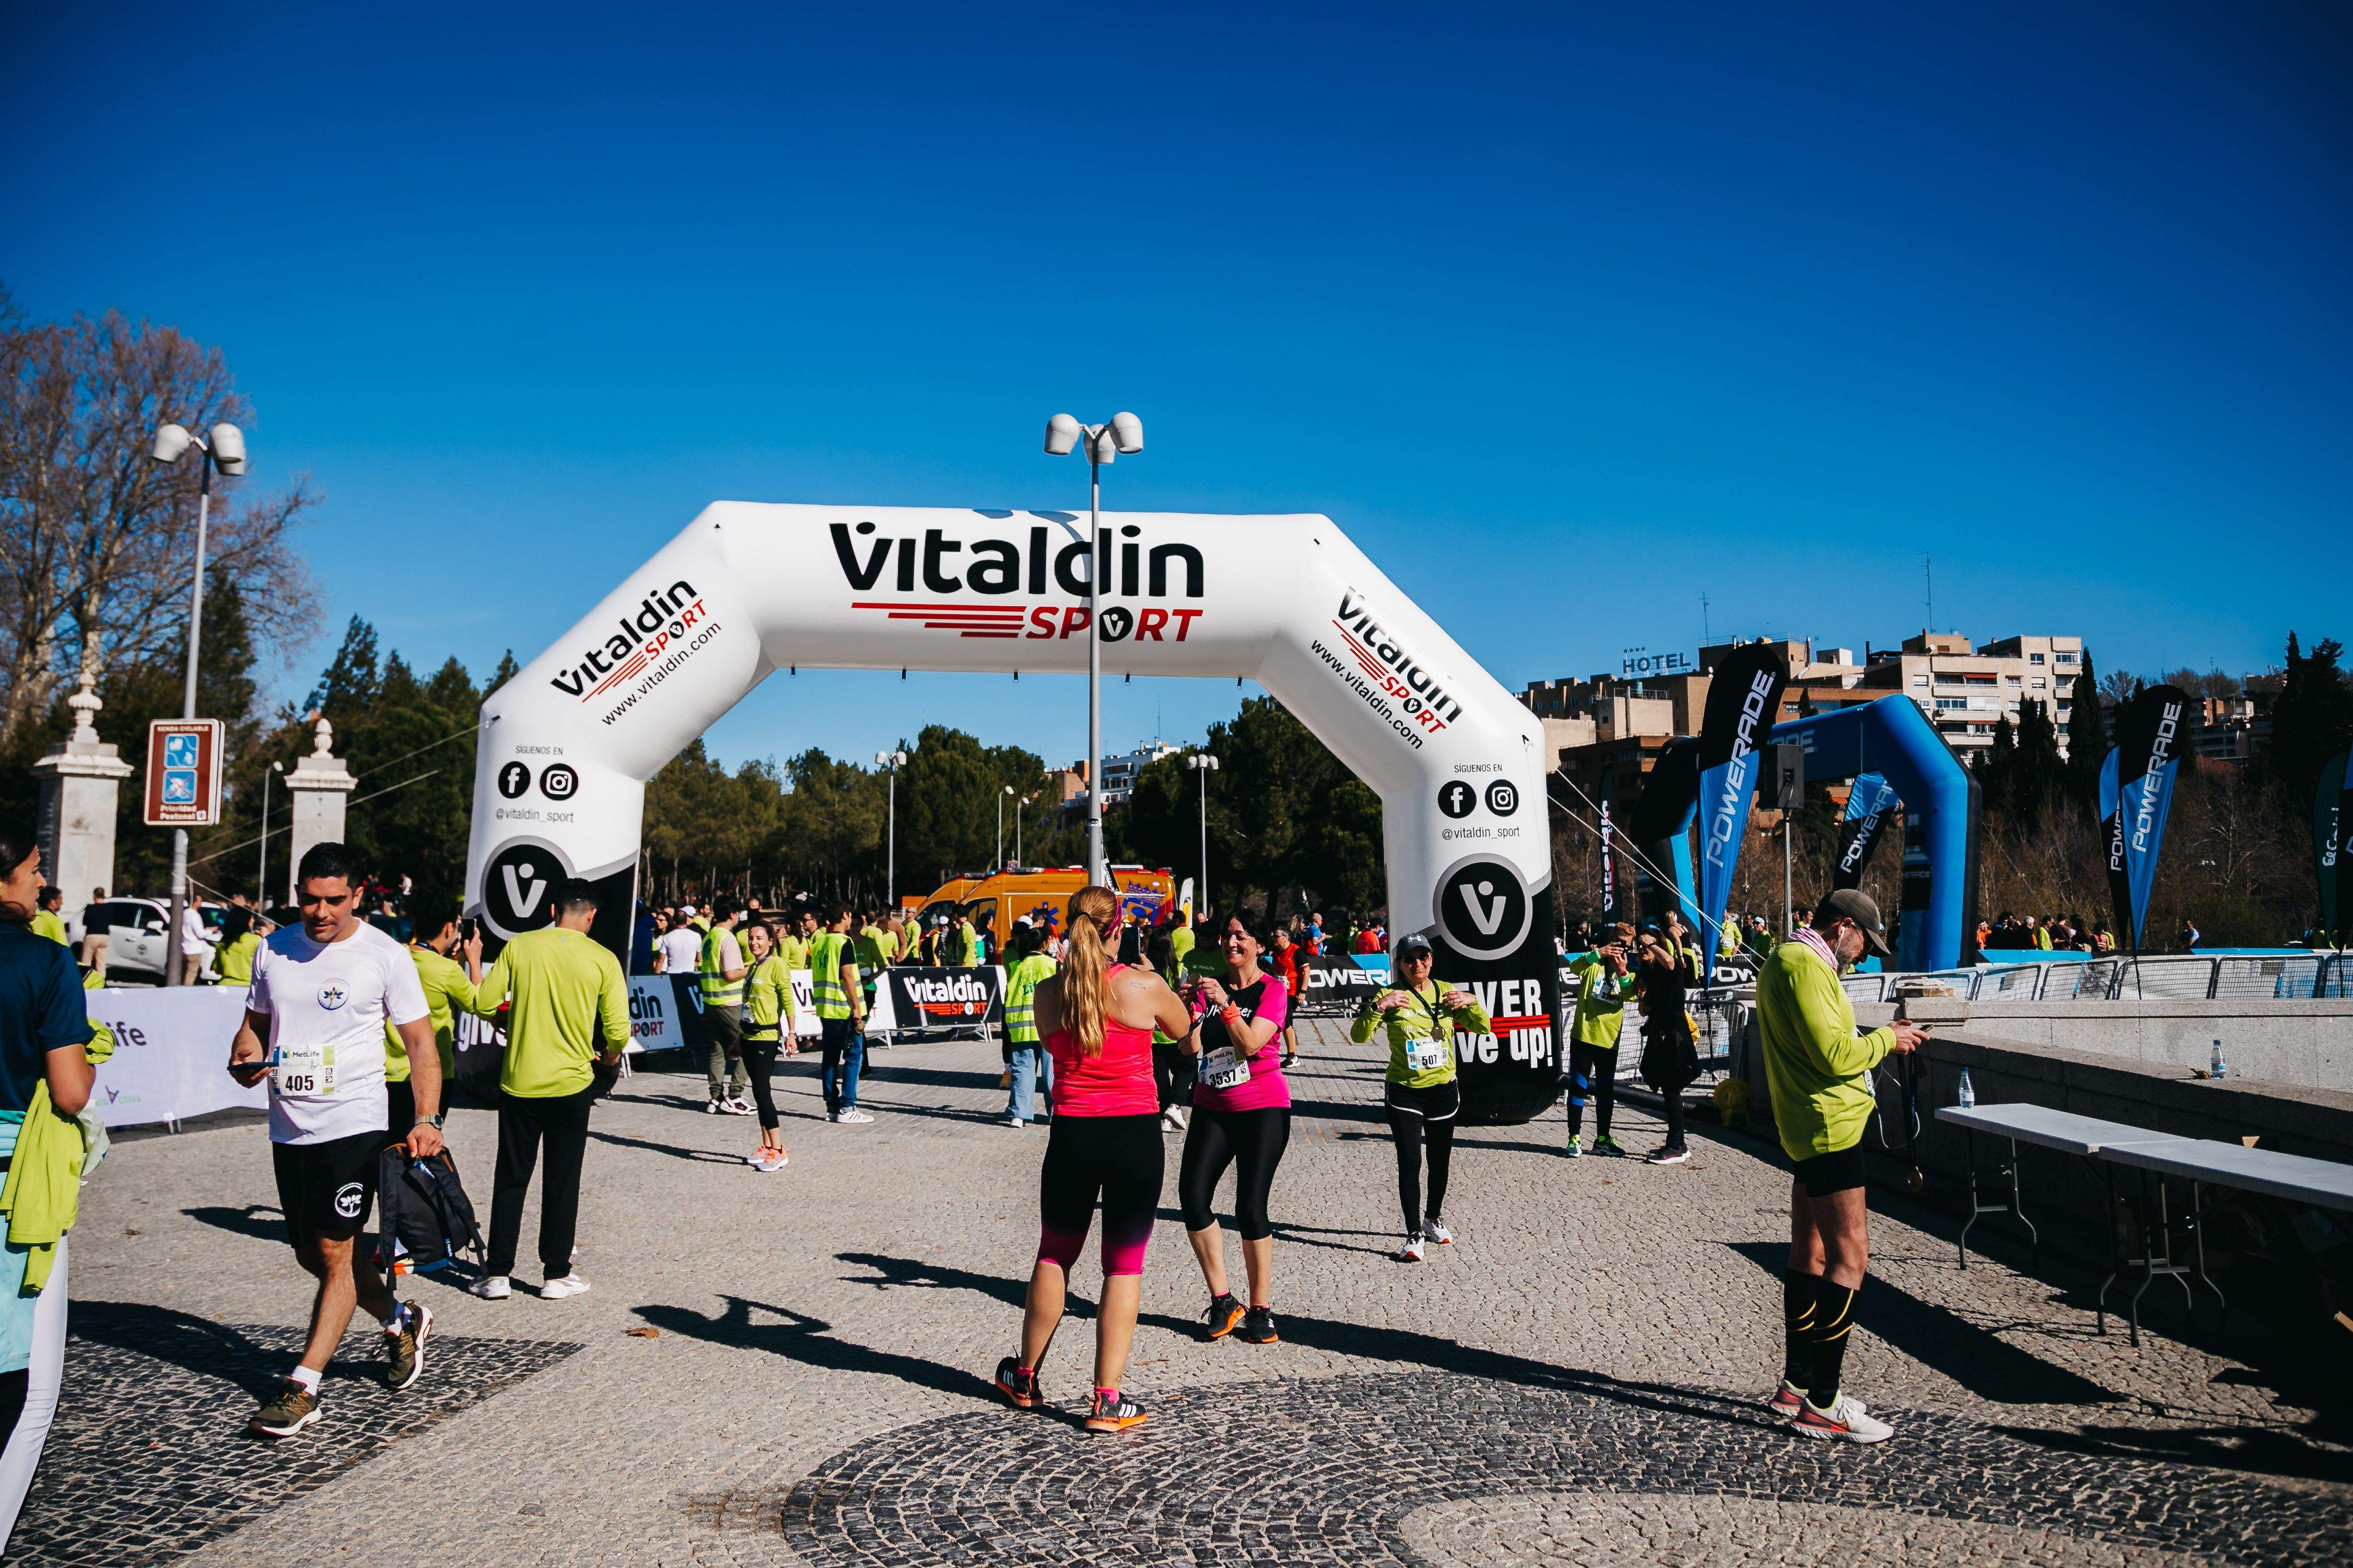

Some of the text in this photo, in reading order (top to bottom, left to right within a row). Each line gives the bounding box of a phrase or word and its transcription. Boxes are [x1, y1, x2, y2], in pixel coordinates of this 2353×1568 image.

[644, 599, 708, 661] SPORT
[1025, 605, 1203, 643] SPORT
[1623, 652, 1691, 674] HOTEL
[602, 623, 721, 726] www.vitaldin.com
[1310, 639, 1423, 750] www.vitaldin.com
[1379, 675, 1447, 734] SPORT
[553, 747, 564, 756] EN
[1454, 763, 1503, 773] SÍGUENOS EN
[1706, 669, 1774, 868] POWERADE
[2132, 702, 2182, 853] POWERADE
[496, 808, 575, 823] @vitaldin_sport
[1442, 826, 1520, 840] @vitaldin_sport
[951, 1002, 987, 1016] SPORT
[1214, 1051, 1234, 1060] MetLife
[1509, 1026, 1553, 1069] up!
[1421, 1054, 1437, 1066] 507
[285, 1075, 314, 1091] 405
[1209, 1069, 1236, 1087] 3537
